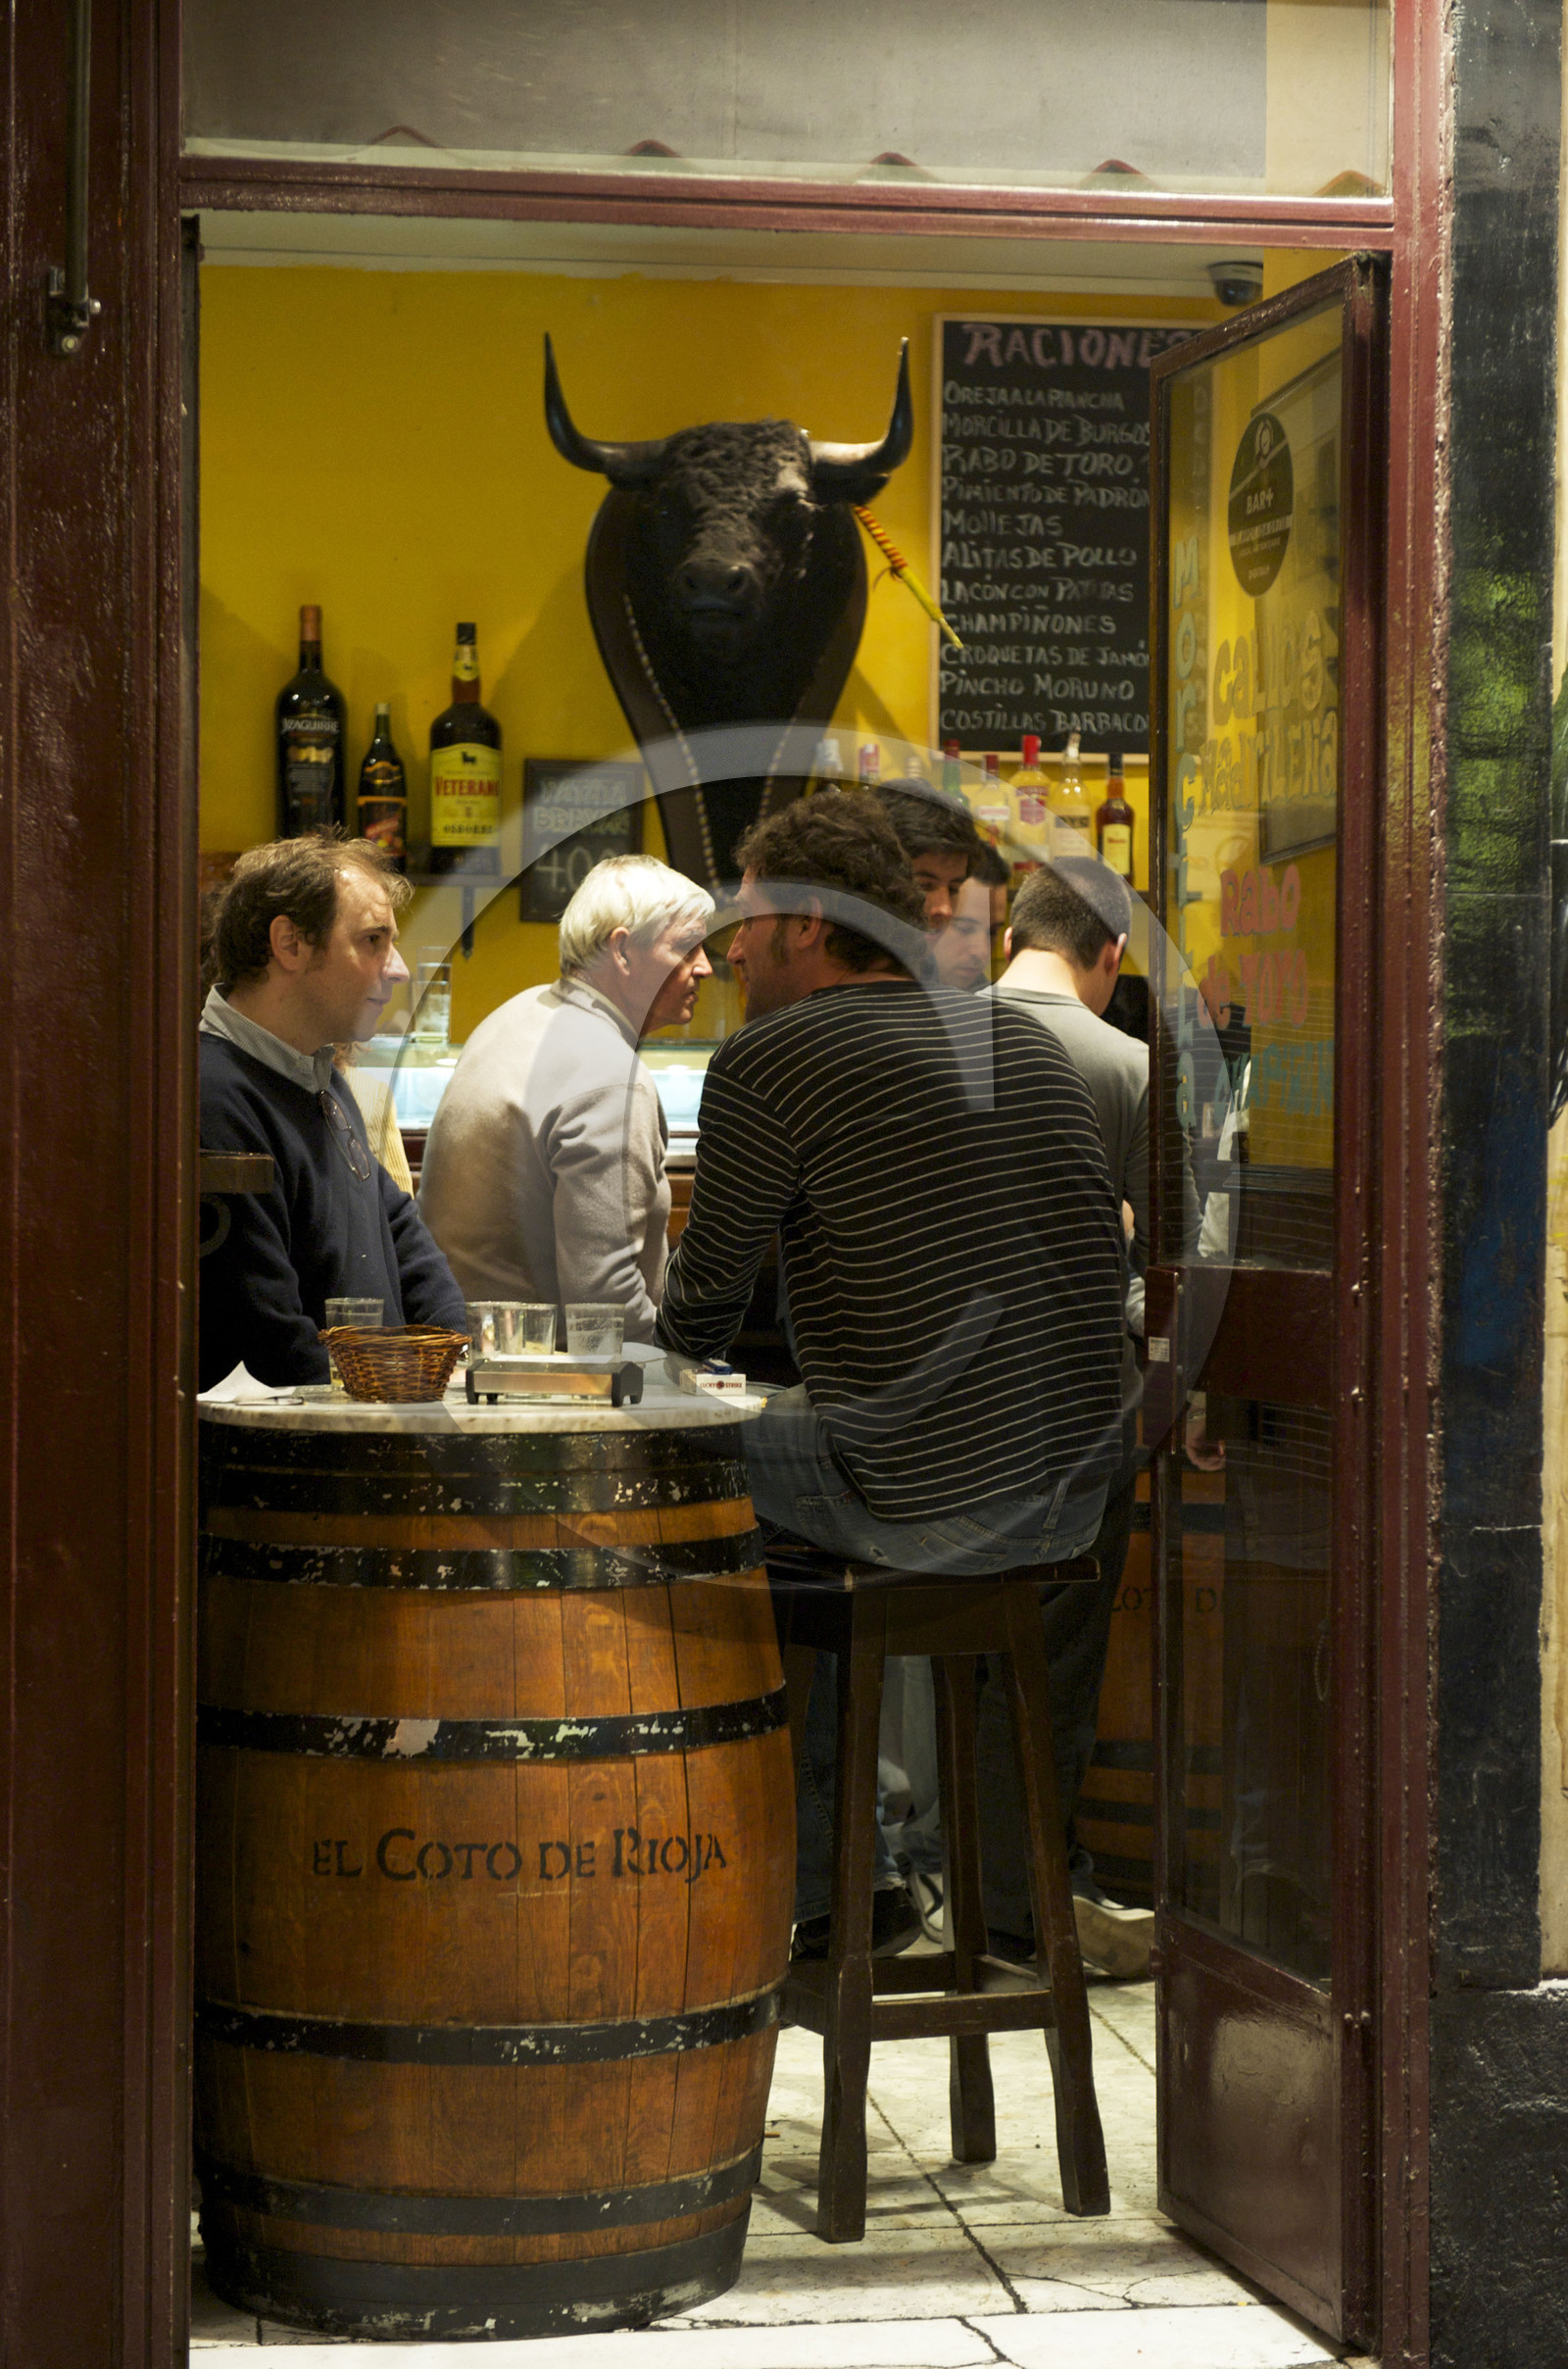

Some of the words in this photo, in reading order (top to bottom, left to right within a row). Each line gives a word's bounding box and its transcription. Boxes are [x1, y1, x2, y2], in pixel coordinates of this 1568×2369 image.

[1042, 418, 1073, 445] DE
[943, 444, 1016, 473] RABO
[1021, 451, 1054, 475] DE
[1054, 451, 1133, 476] TORO
[1042, 486, 1068, 504] DE
[1024, 546, 1056, 568] DE
[1056, 542, 1137, 567] POLLO
[1067, 647, 1090, 666] DE
[1097, 640, 1150, 666] JAMÓ
[1033, 673, 1135, 700] MORUNO
[1049, 709, 1150, 734] BARBACO
[376, 1828, 522, 1882] COTO
[538, 1841, 596, 1881] DE
[612, 1827, 727, 1884] RIOJA
